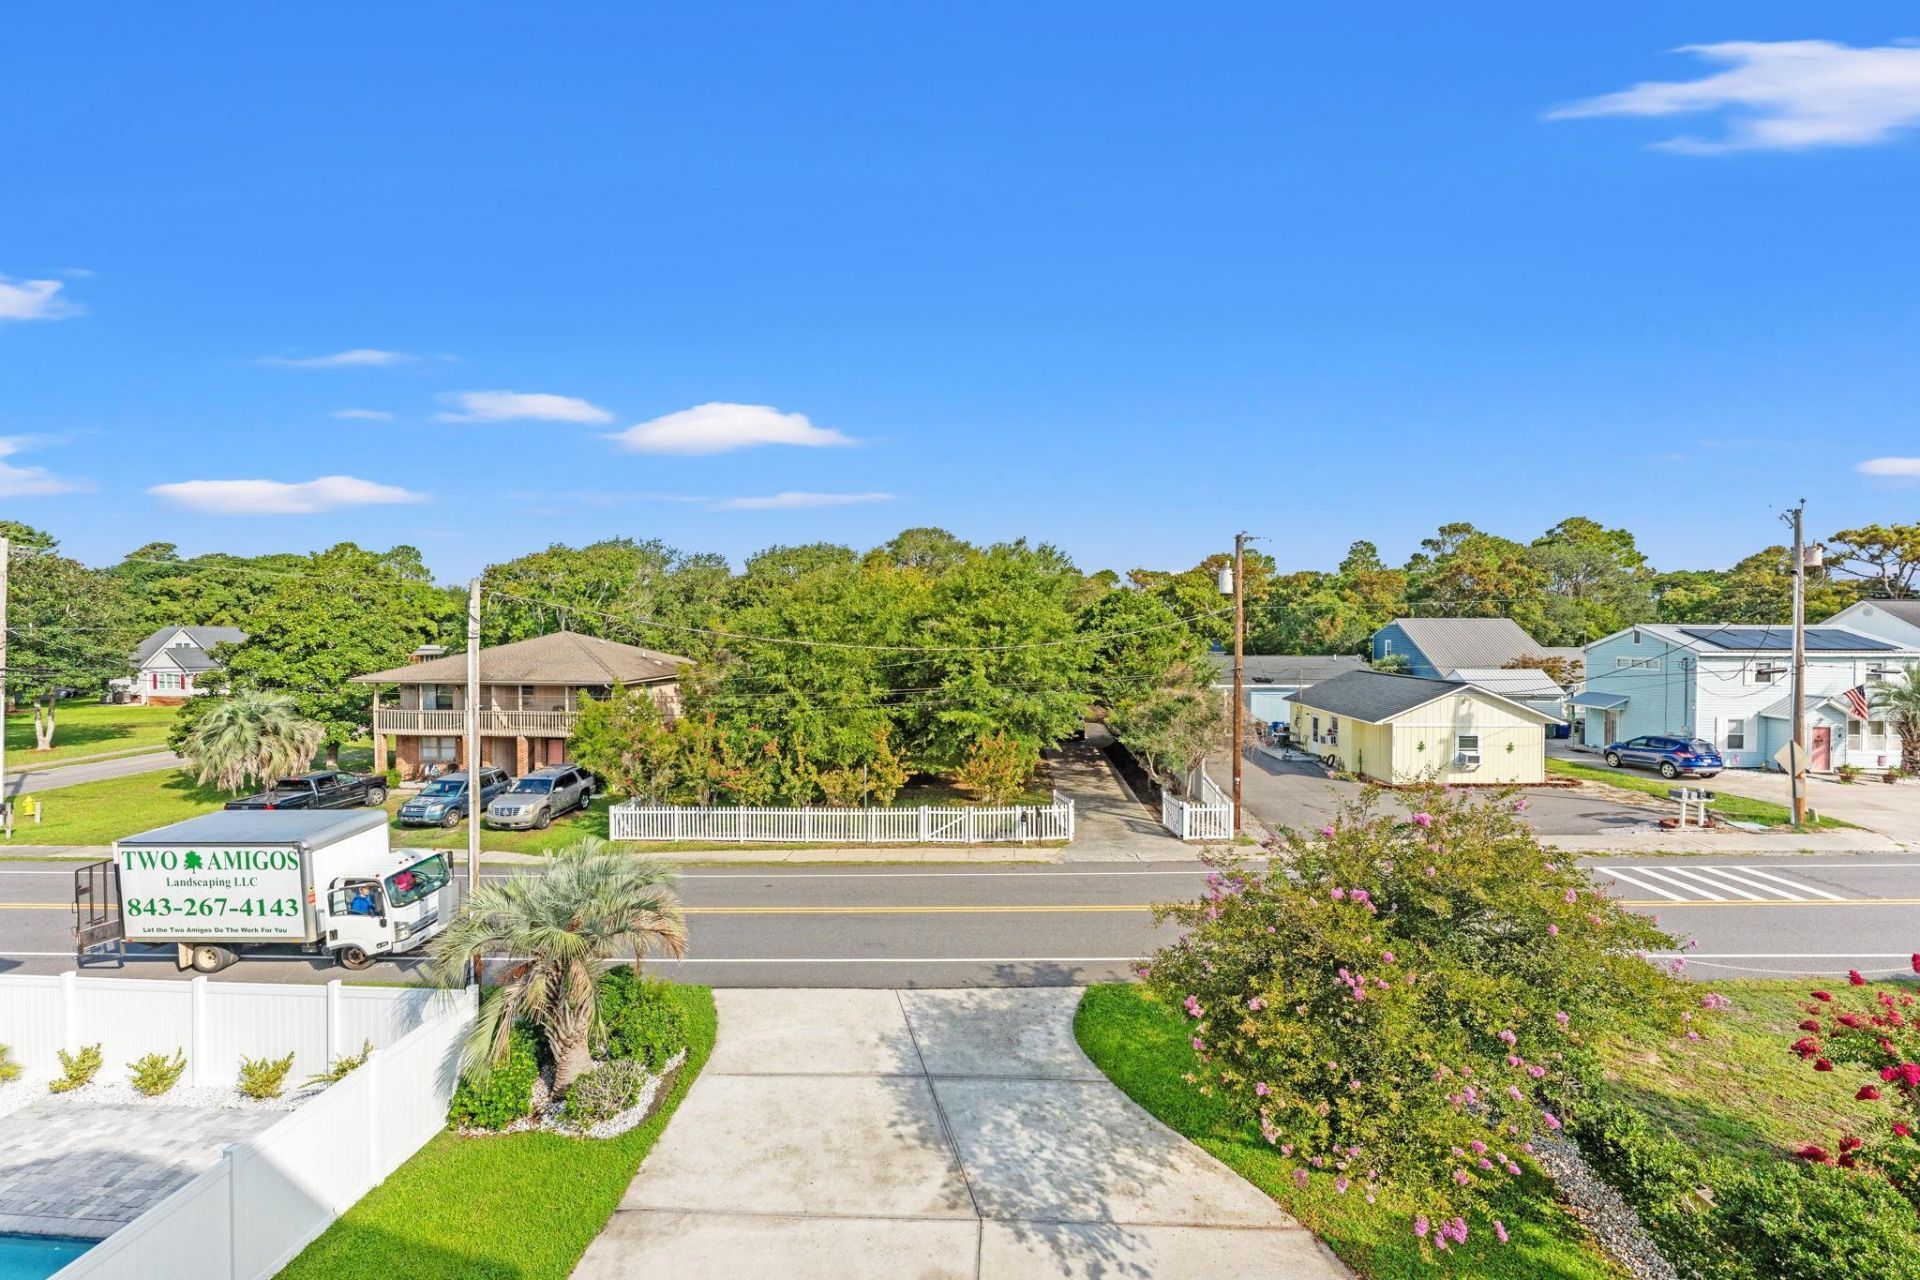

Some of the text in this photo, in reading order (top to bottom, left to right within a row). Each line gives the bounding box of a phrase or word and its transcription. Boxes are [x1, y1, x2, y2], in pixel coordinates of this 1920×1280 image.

[121, 850, 299, 871] TWO AMIGOS
[166, 877, 258, 889] Landscaping LLC
[127, 897, 299, 917] 843-267-4143
